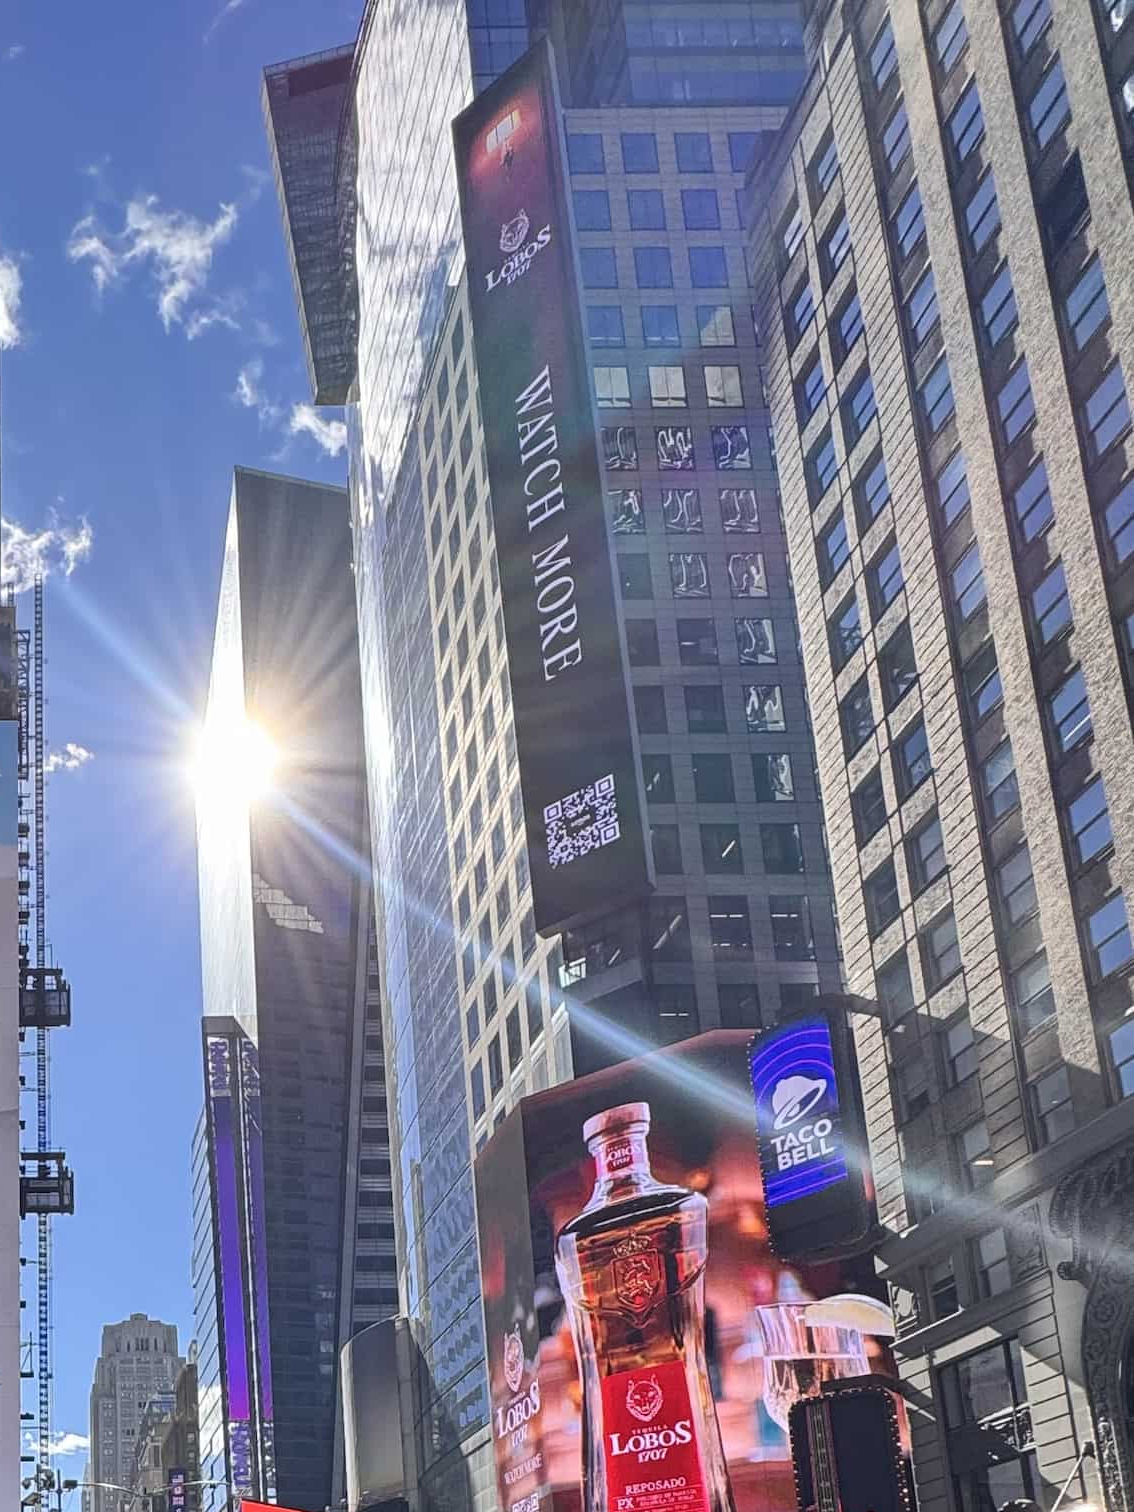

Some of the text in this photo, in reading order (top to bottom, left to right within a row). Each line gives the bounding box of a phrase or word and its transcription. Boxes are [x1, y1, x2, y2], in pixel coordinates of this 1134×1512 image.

[485, 224, 551, 292] LOBOS
[515, 364, 583, 681] WATCH MORE
[770, 1118, 832, 1154] TACO
[777, 1137, 835, 1171] BELL
[497, 1378, 541, 1439] LOBOS
[609, 1420, 692, 1456] LOBOS
[638, 1448, 668, 1463] 1707
[617, 1497, 634, 1510] PX
[625, 1477, 686, 1496] REPOSADO
